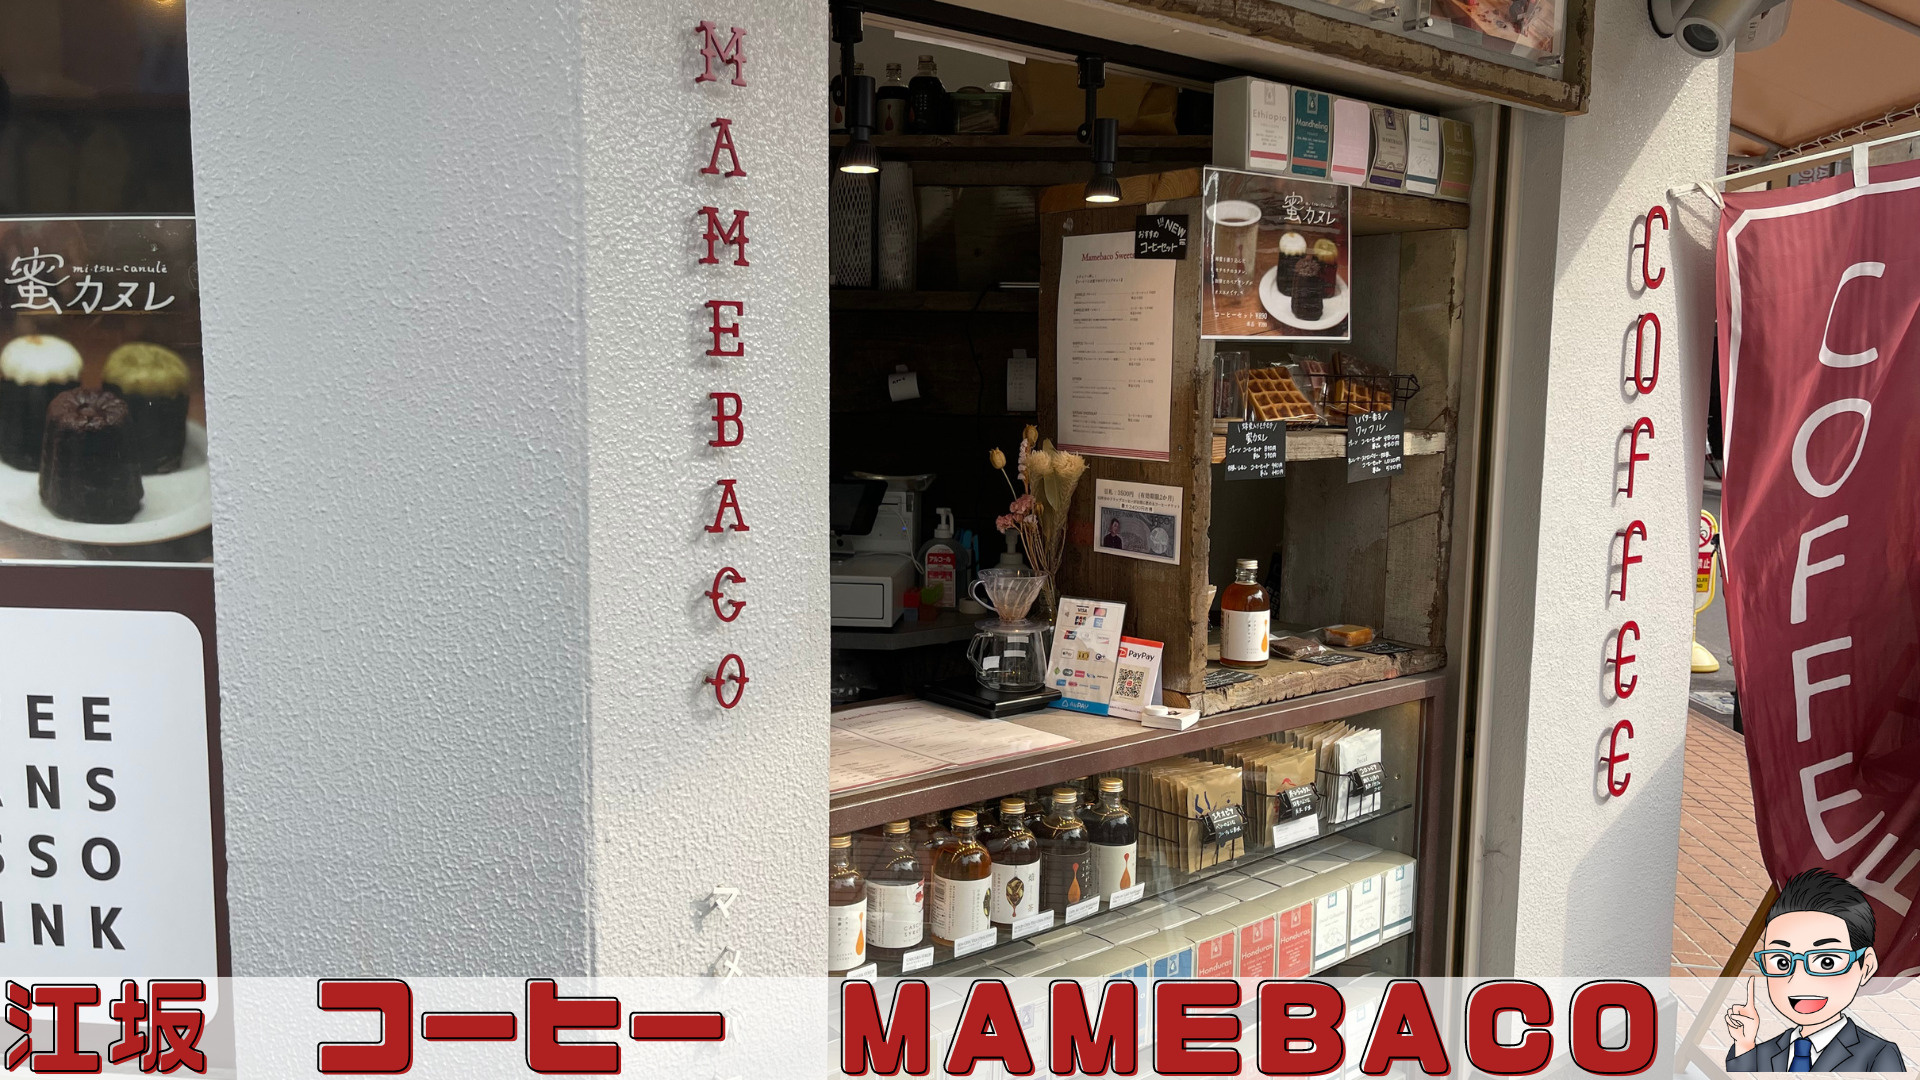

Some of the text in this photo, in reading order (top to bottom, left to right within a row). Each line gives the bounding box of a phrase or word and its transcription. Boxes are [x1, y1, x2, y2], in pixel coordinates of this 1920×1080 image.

[1252, 108, 1288, 123] Ethiopia
[1295, 117, 1329, 133] Mandheling
[1281, 191, 1336, 225] 蜜カヌレ
[1164, 219, 1187, 239] NEW
[1081, 252, 1114, 262] Mamebaco
[4, 246, 175, 315] 蜜カヌレ
[695, 19, 750, 710] MAMEBACO
[1355, 424, 1387, 437] ワッフル
[1128, 650, 1155, 662] PayPay
[0, 764, 117, 812] NS
[1280, 928, 1311, 945] Honduras
[1241, 943, 1273, 960] Honduras
[1198, 959, 1233, 977] Honduras
